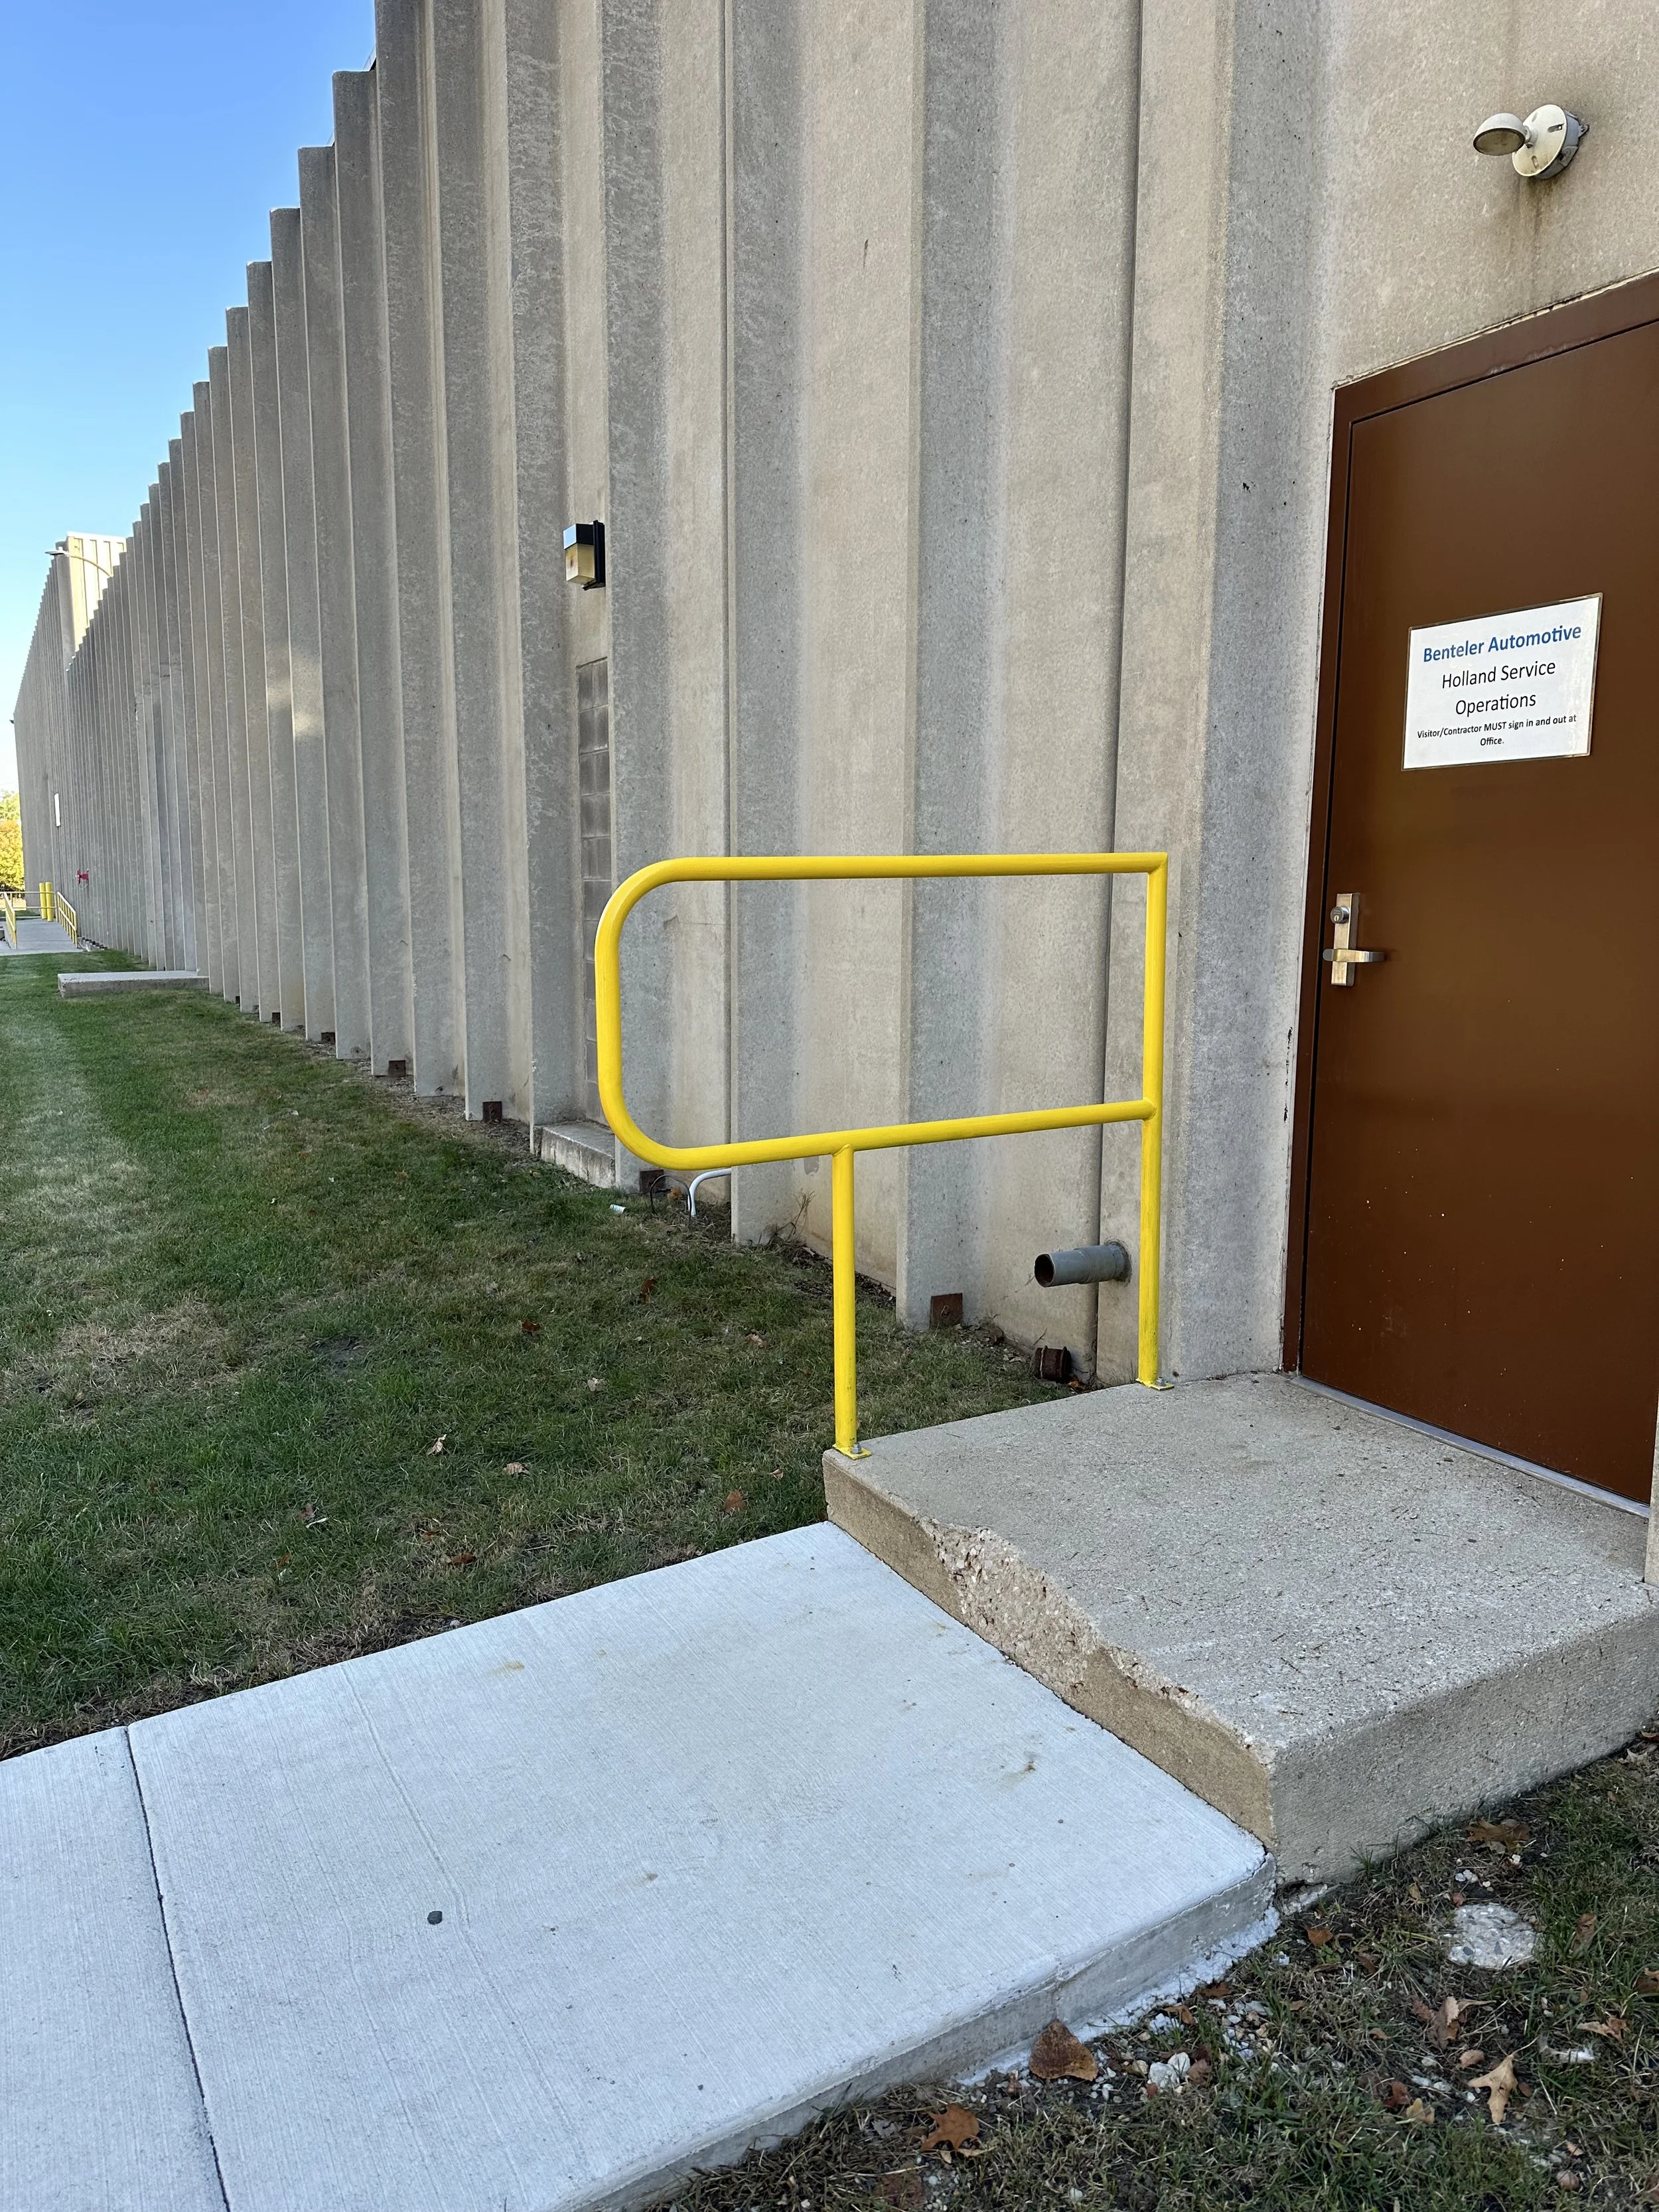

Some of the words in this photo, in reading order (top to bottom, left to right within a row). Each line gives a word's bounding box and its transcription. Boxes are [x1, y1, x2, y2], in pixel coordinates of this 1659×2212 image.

[1424, 640, 1484, 662] Benteler
[1488, 625, 1581, 652] Automotive
[1442, 666, 1496, 689] Holland
[1501, 661, 1555, 681] Service
[1455, 694, 1536, 717] Operations
[1417, 725, 1482, 738] Visitor/Contractor
[1484, 721, 1506, 731] MUST
[1508, 720, 1524, 730] sign
[1536, 716, 1551, 726] and
[1553, 715, 1567, 724] out
[1569, 714, 1577, 723] at
[1480, 737, 1504, 746] Office.
